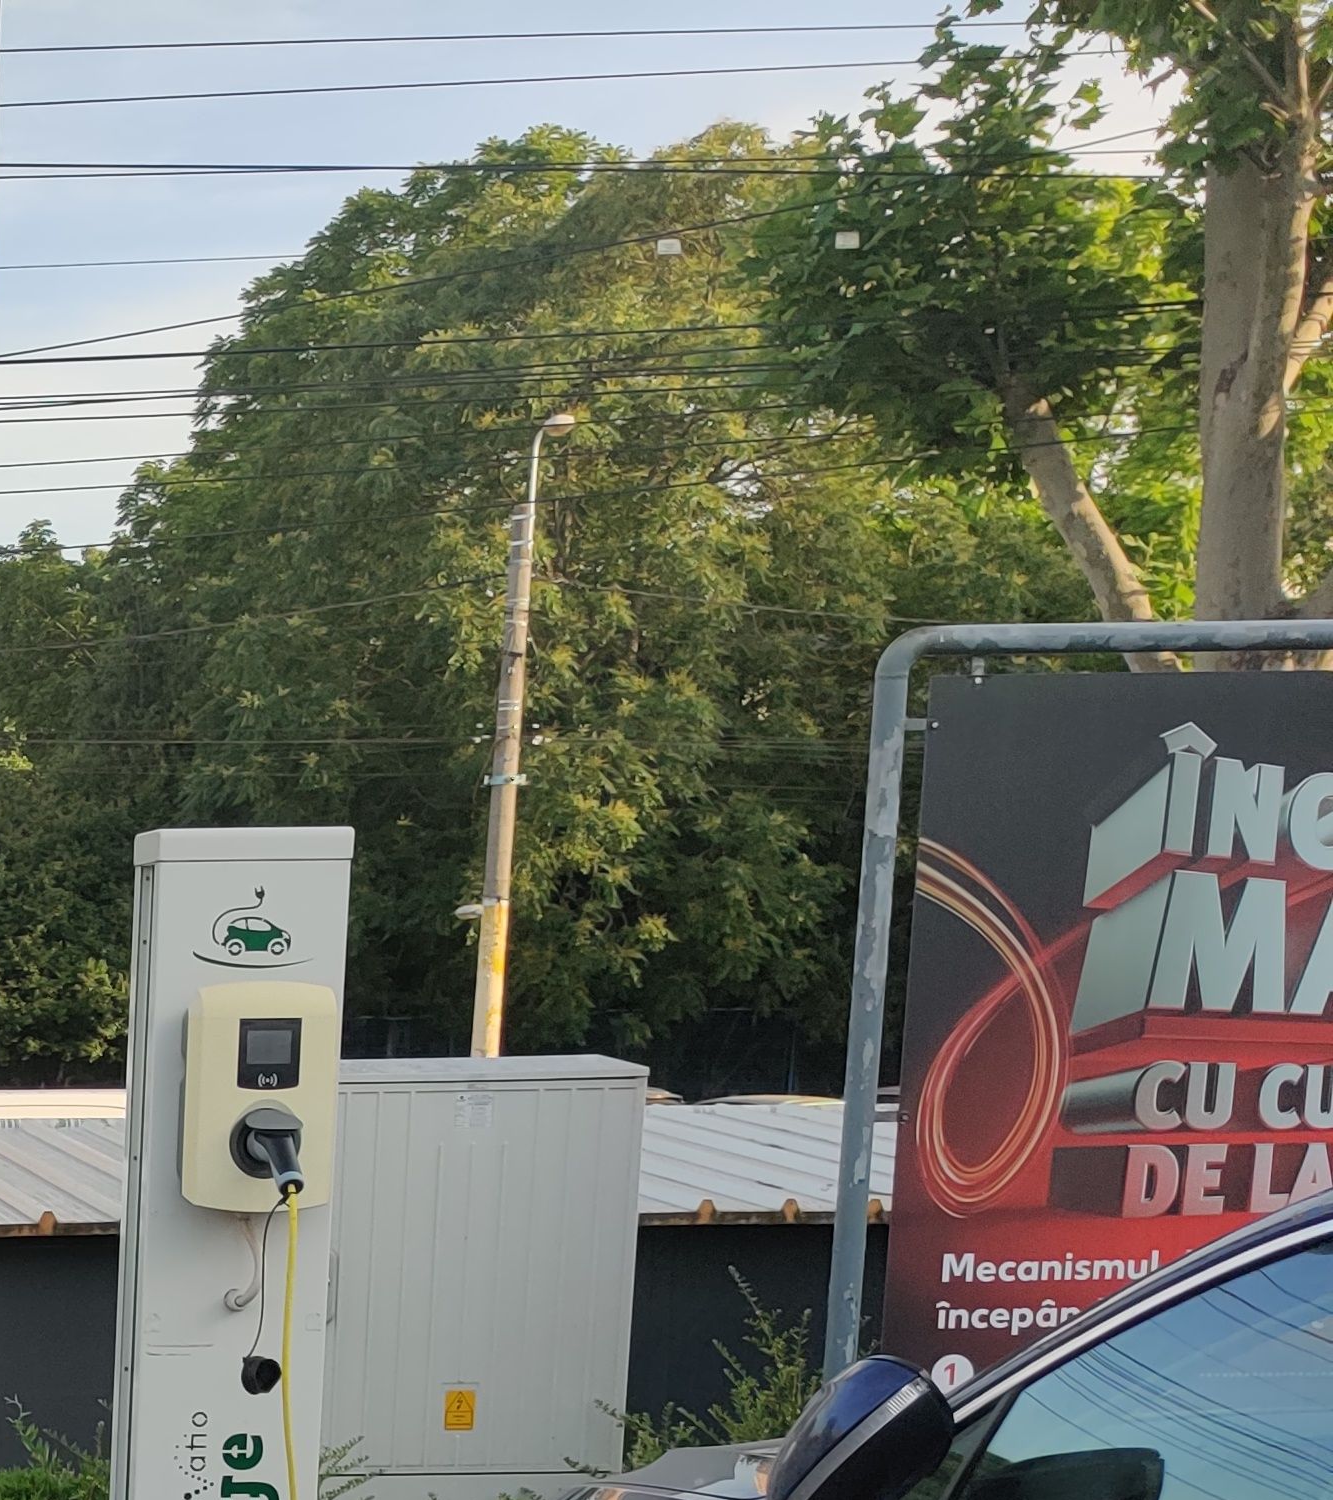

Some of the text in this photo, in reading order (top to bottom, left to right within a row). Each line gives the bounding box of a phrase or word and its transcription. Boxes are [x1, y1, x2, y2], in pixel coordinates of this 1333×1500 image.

[1135, 1060, 1237, 1130] CU
[1121, 1143, 1228, 1218] DE
[941, 1250, 1160, 1283] Mecanismul
[935, 1299, 1093, 1336] începân
[942, 1363, 955, 1386] 1
